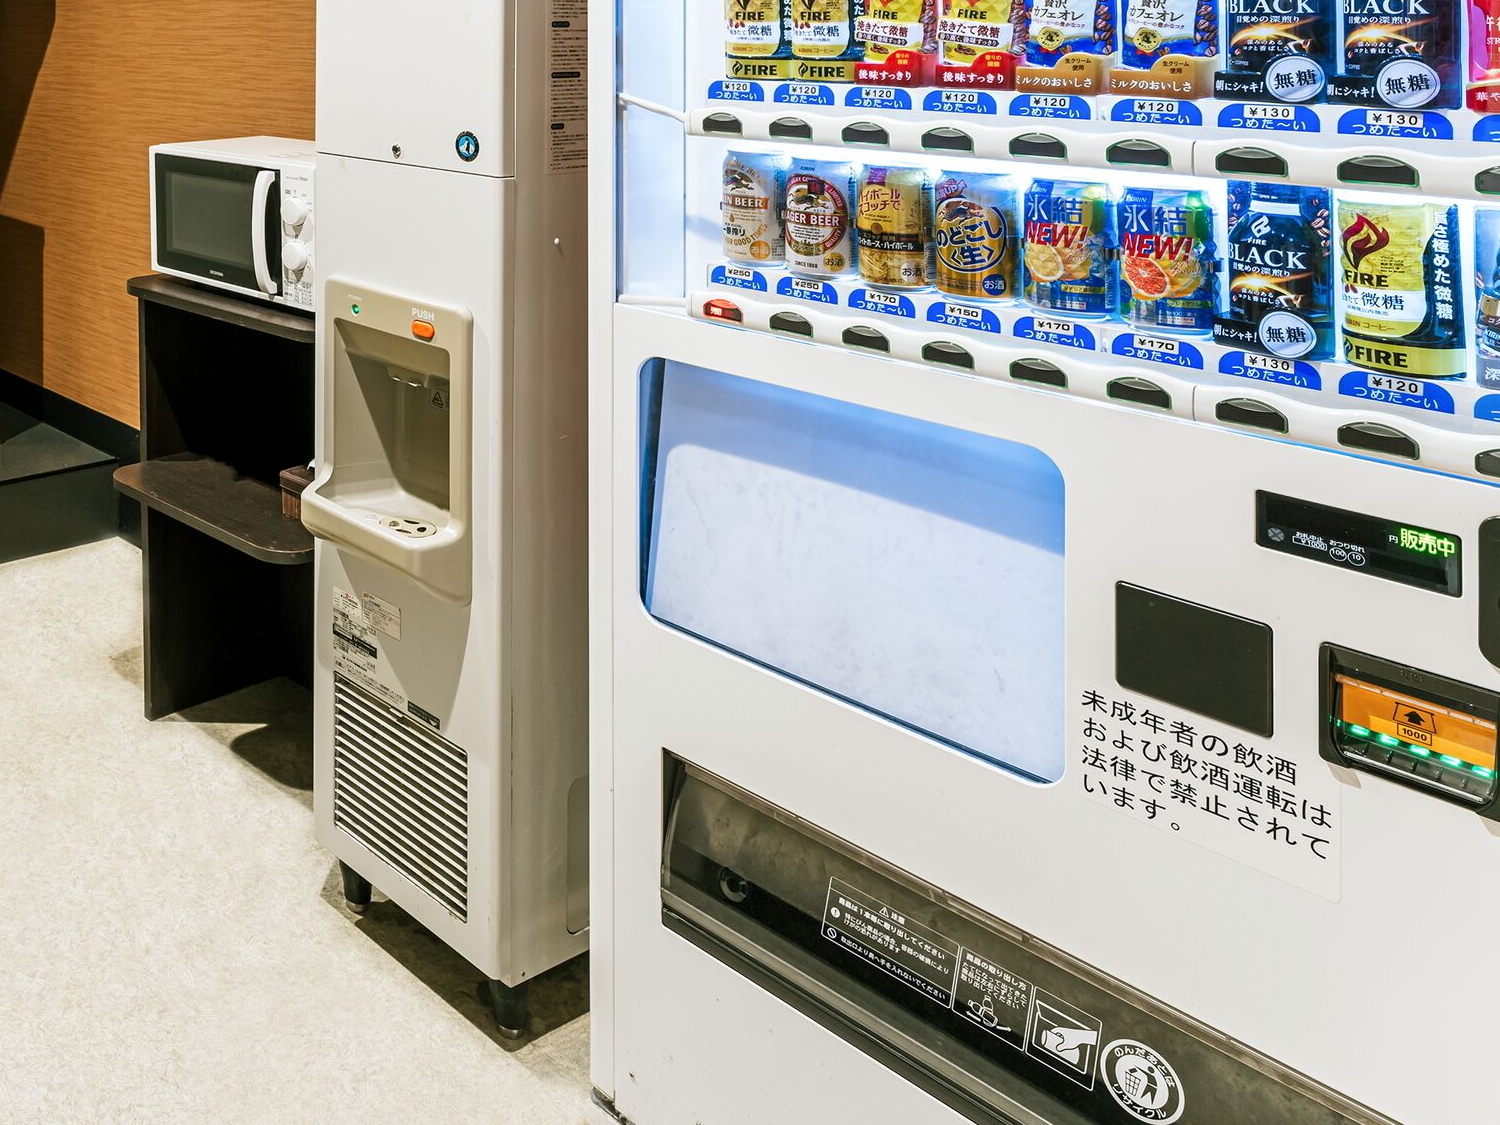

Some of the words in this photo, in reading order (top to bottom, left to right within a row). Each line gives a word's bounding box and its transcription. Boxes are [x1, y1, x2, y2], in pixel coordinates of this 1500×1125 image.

[735, 11, 765, 21] FIRE
[800, 11, 831, 21] FIRE
[1033, 5, 1085, 22] カフェオレ
[1129, 5, 1185, 23] カフェオレ
[857, 20, 909, 38] 挽きたて微糖
[938, 20, 1001, 39] 挽きたて微糖
[743, 64, 778, 76] FIRE
[809, 66, 845, 78] FIRE
[858, 69, 912, 81] 後味すっきり
[942, 71, 1004, 84] 後味すっきり
[1015, 75, 1093, 89] ミルクのおいしさ
[1110, 78, 1193, 93] ミルクのおいしさ
[1273, 69, 1318, 89] 無糖
[1384, 73, 1430, 94] 無糖
[724, 82, 748, 92] ¥120
[791, 86, 817, 95] ¥120
[864, 89, 892, 99] ¥120
[944, 93, 975, 103] ¥120
[1033, 97, 1067, 107] ¥120
[1137, 101, 1175, 113] ¥120
[1249, 107, 1291, 119] ¥130
[1371, 113, 1419, 126] ¥130
[734, 196, 764, 209] BEER
[1027, 194, 1085, 225] 氷結
[810, 214, 840, 226] BEER
[1124, 204, 1188, 236] 氷結
[937, 219, 1003, 247] のどごし
[1229, 242, 1308, 270] BLACK
[727, 268, 751, 278] ¥250
[1343, 270, 1390, 288] FIRE
[794, 280, 820, 291] ¥250
[869, 293, 897, 305] ¥170
[411, 307, 435, 322] PUSH
[948, 306, 979, 318] ¥150
[1037, 320, 1071, 332] ¥170
[1265, 325, 1307, 344] 無糖
[1137, 337, 1176, 351] ¥170
[1248, 355, 1290, 372] ¥130
[1355, 344, 1409, 369] FIRE
[1372, 376, 1419, 395] ¥120
[1328, 539, 1366, 554] おつり切れ
[1388, 534, 1399, 544] 円
[1400, 527, 1456, 558] 販売中
[1331, 548, 1346, 558] 100
[1351, 553, 1362, 562] 10
[1080, 689, 1297, 787] 未成年者の飲酒
[1402, 727, 1428, 742] 1000
[1082, 718, 1333, 830] および飲酒運転は
[1081, 744, 1331, 860] 法律で禁止されて
[1083, 773, 1181, 832] います。
[965, 952, 1028, 992] 商品の取り出し方
[961, 967, 1027, 1009] 商品は左右にずらして
[962, 961, 1028, 1003] たてになって出てきた
[960, 974, 1020, 1011] 取り出してください
[1114, 1045, 1176, 1088] のんだあとは
[1112, 1083, 1167, 1119] リサイクル
